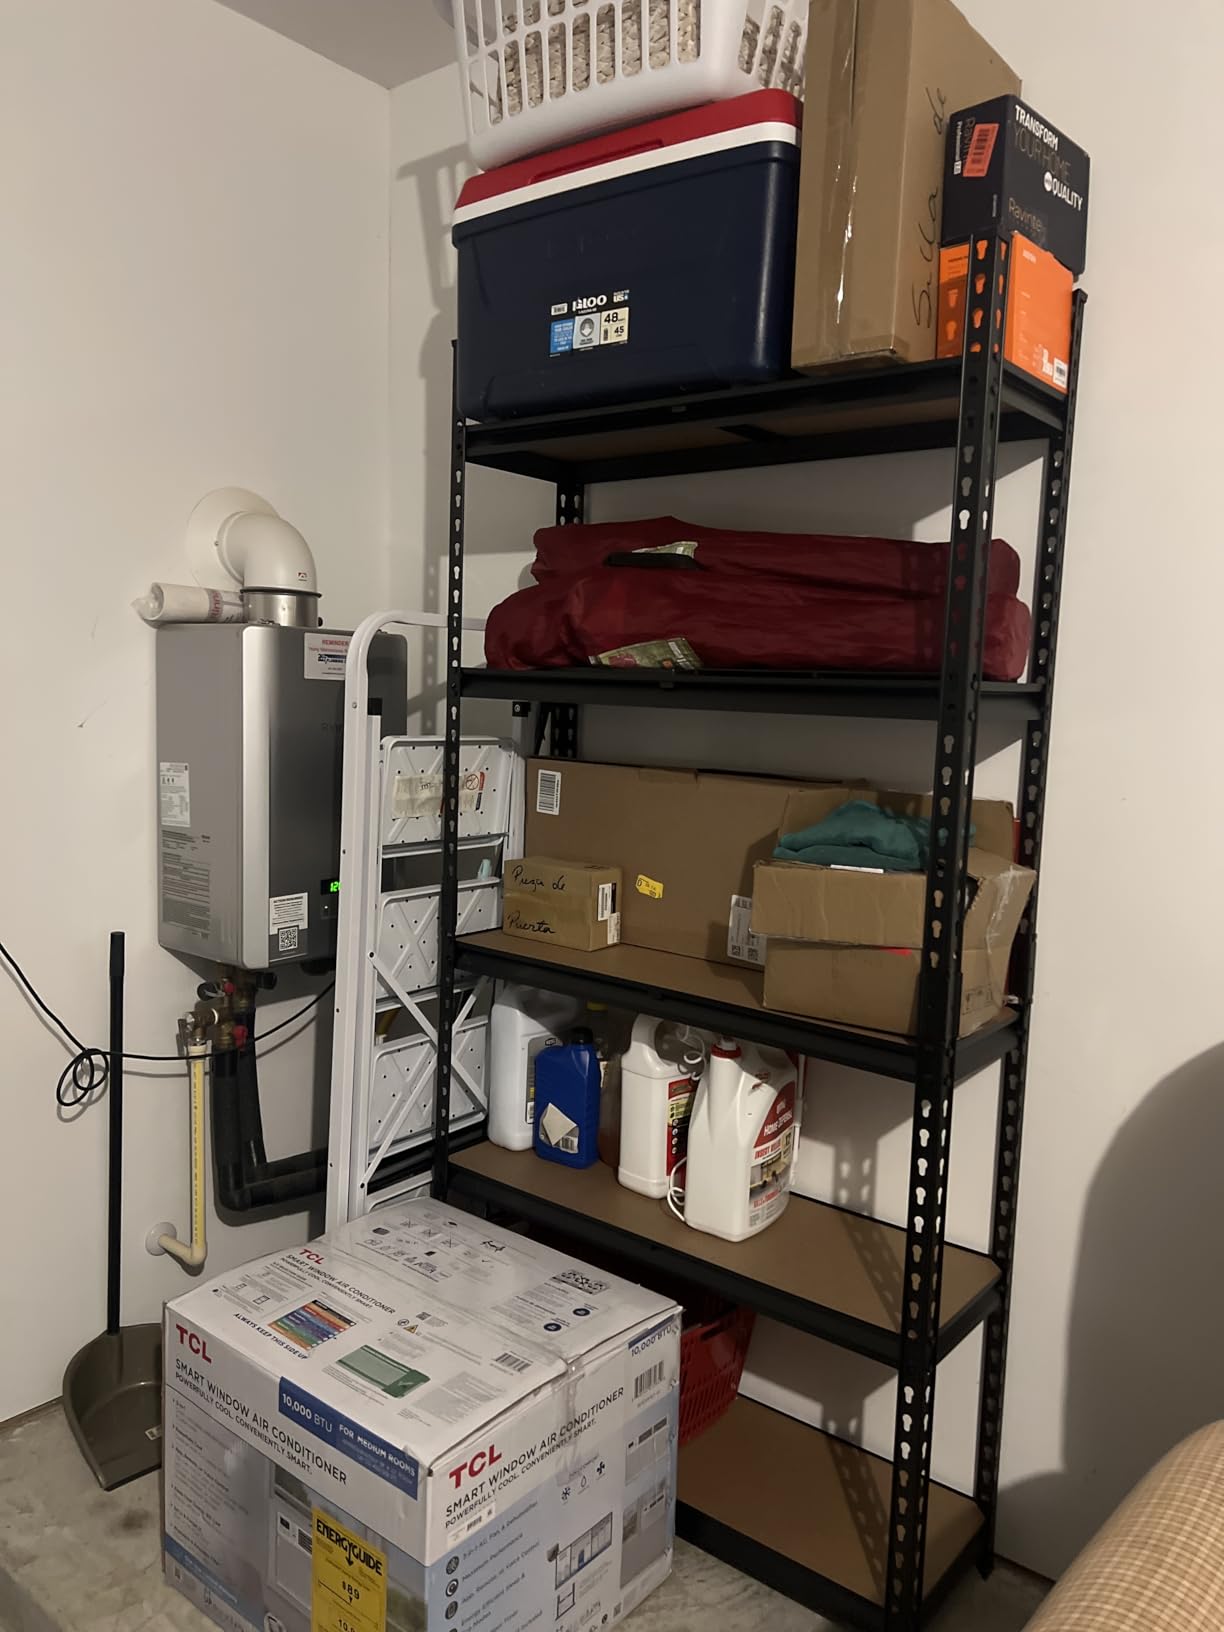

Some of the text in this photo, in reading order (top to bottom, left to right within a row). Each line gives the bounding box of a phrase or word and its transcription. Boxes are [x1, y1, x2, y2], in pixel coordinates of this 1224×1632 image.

[1015, 104, 1059, 151] TRANSFORM
[1052, 178, 1083, 211] QUALITY
[572, 294, 607, 312] IGLOO
[604, 312, 619, 323] 48
[614, 326, 624, 334] 45
[507, 910, 556, 934] Puerta
[299, 1248, 326, 1265] TCL
[286, 1254, 396, 1314] SMART WINDOW AIR CONDITIONER
[176, 1323, 212, 1364] TCL
[234, 1312, 308, 1360] ALWAYS KEEP THIS SIDE UP
[631, 1336, 656, 1357] 10,000
[176, 1371, 214, 1404] POWERFULLY
[235, 1415, 285, 1455] CONVENIENTLY
[176, 1358, 205, 1387] SMART
[207, 1380, 250, 1418] WINDOW
[252, 1413, 269, 1433] AIR
[271, 1426, 347, 1485] CONDITIONER
[282, 1393, 312, 1420] 10,000
[314, 1413, 333, 1433] BTU
[339, 1424, 354, 1440] FOR
[357, 1435, 387, 1459] MEDIUM
[388, 1454, 416, 1478] ROOMS
[446, 1481, 486, 1518] SMART
[489, 1445, 537, 1487] WINDOW
[539, 1432, 557, 1452] AIR
[559, 1387, 624, 1437] CONDITIONER
[449, 1444, 502, 1489] TCL
[445, 1487, 497, 1529] POWERFULLY
[521, 1433, 573, 1474] CONVENIENTLY
[316, 1518, 383, 1577] ENERGYGUIDE
